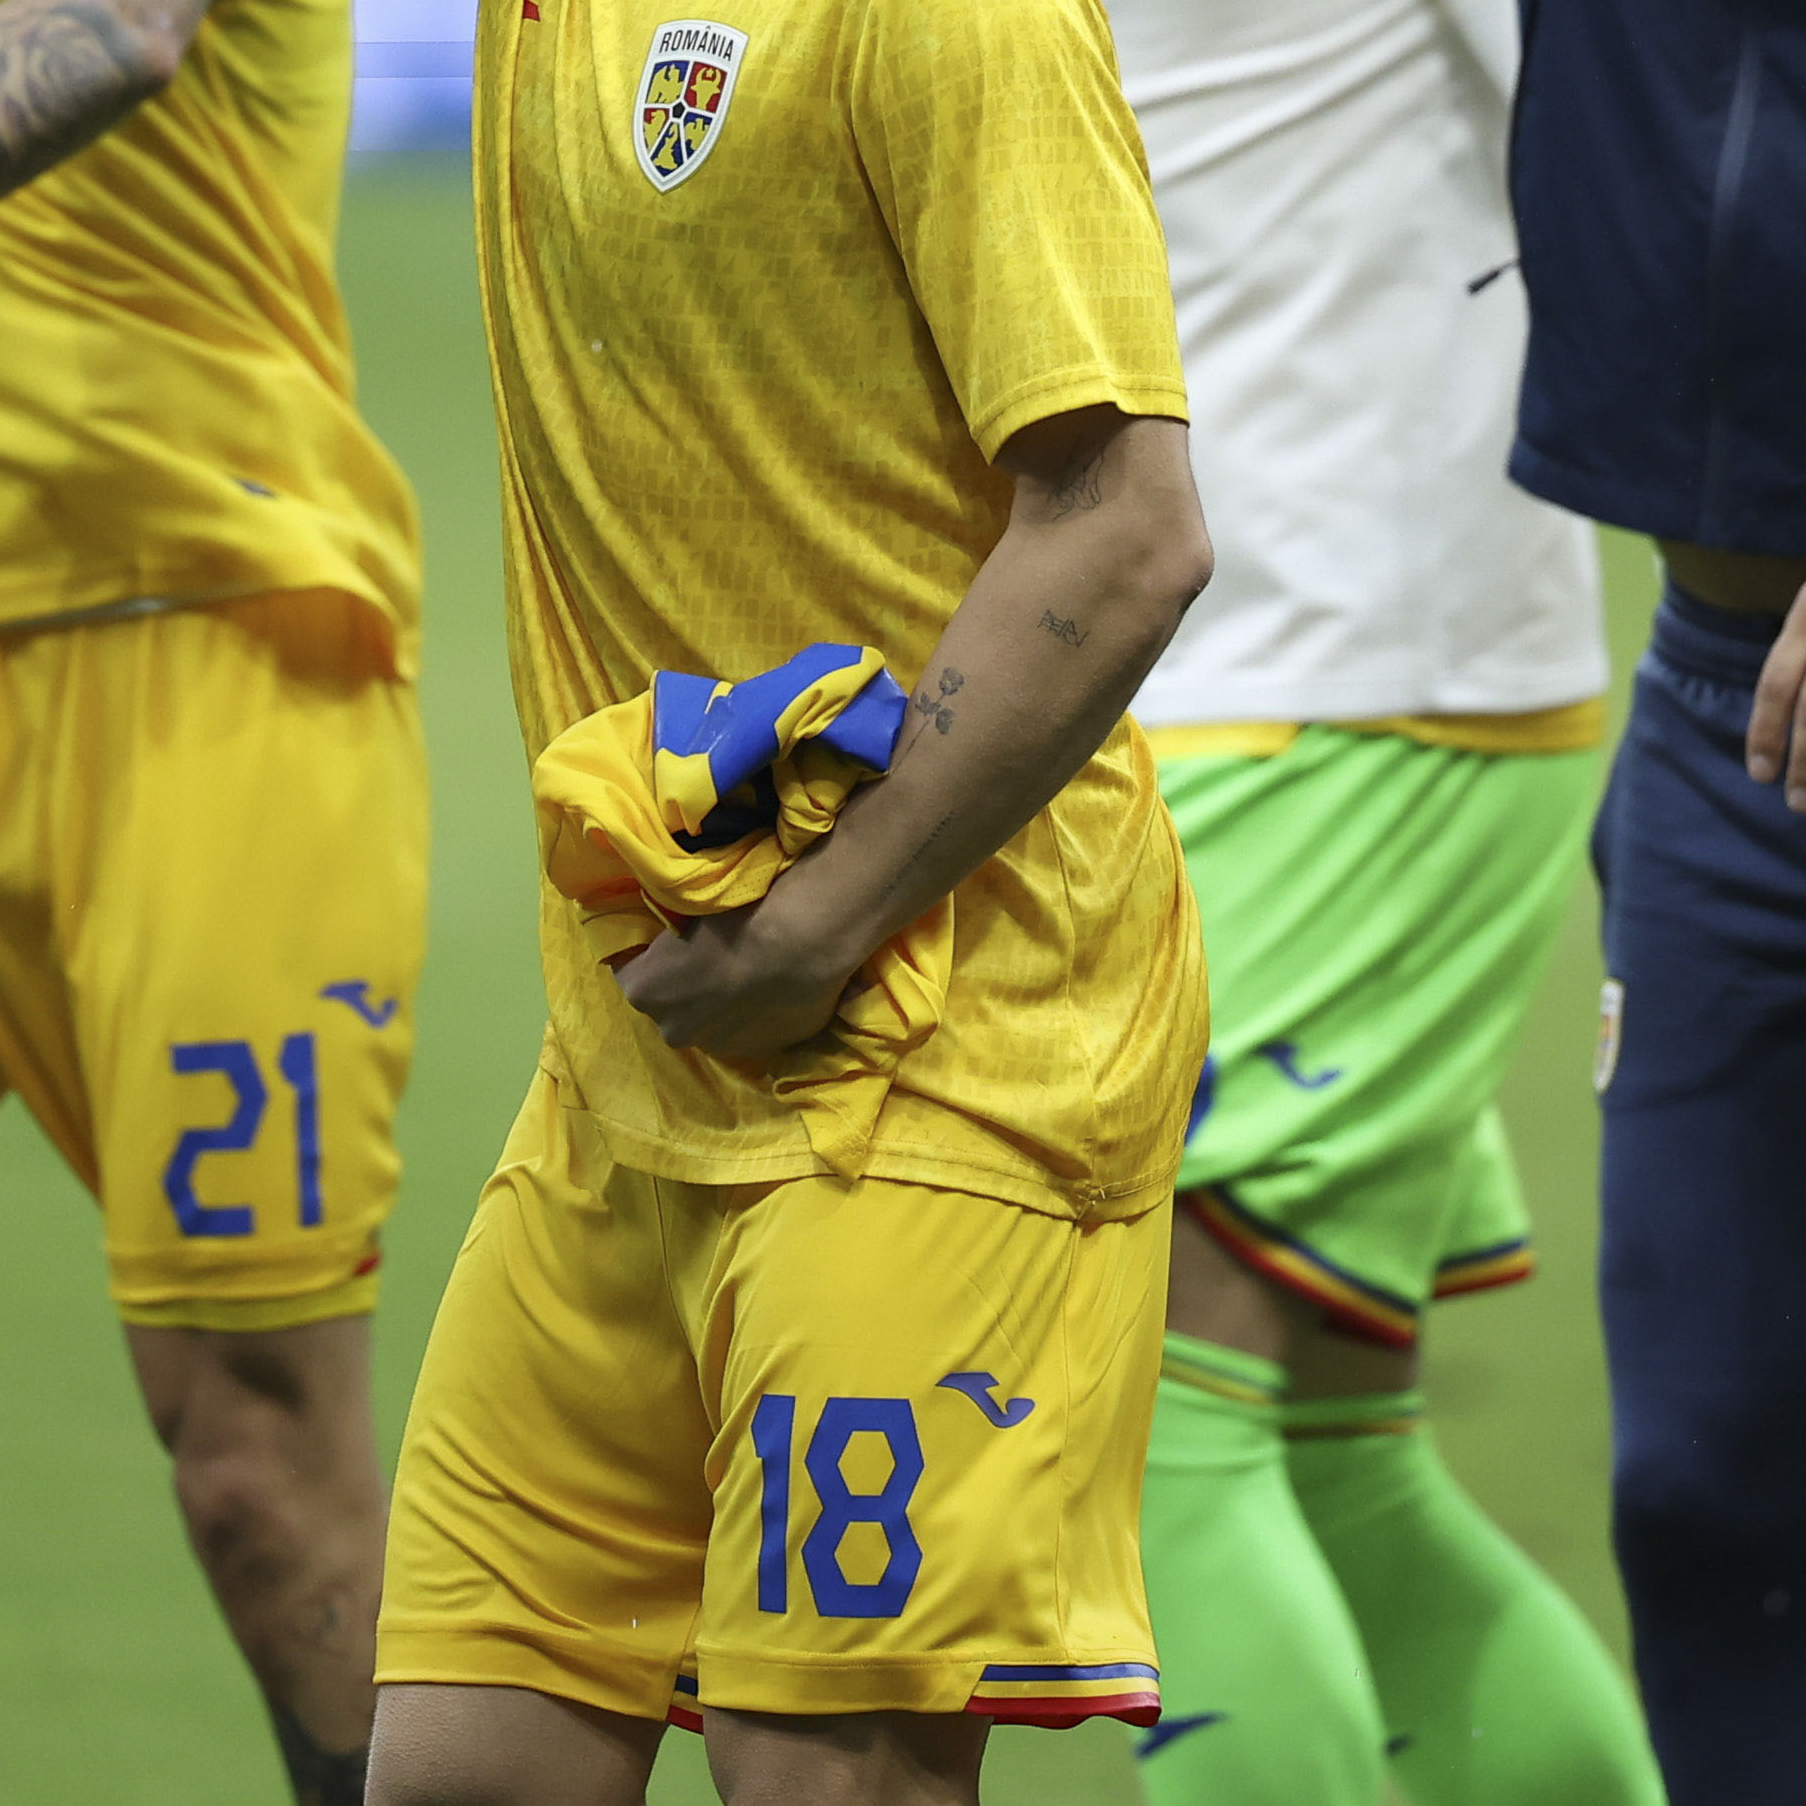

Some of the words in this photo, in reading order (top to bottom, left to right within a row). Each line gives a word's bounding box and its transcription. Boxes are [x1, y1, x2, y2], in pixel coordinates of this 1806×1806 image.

[658, 25, 735, 62] ROMÂNIA
[162, 1031, 324, 1238] 21
[751, 1394, 926, 1618] 18
